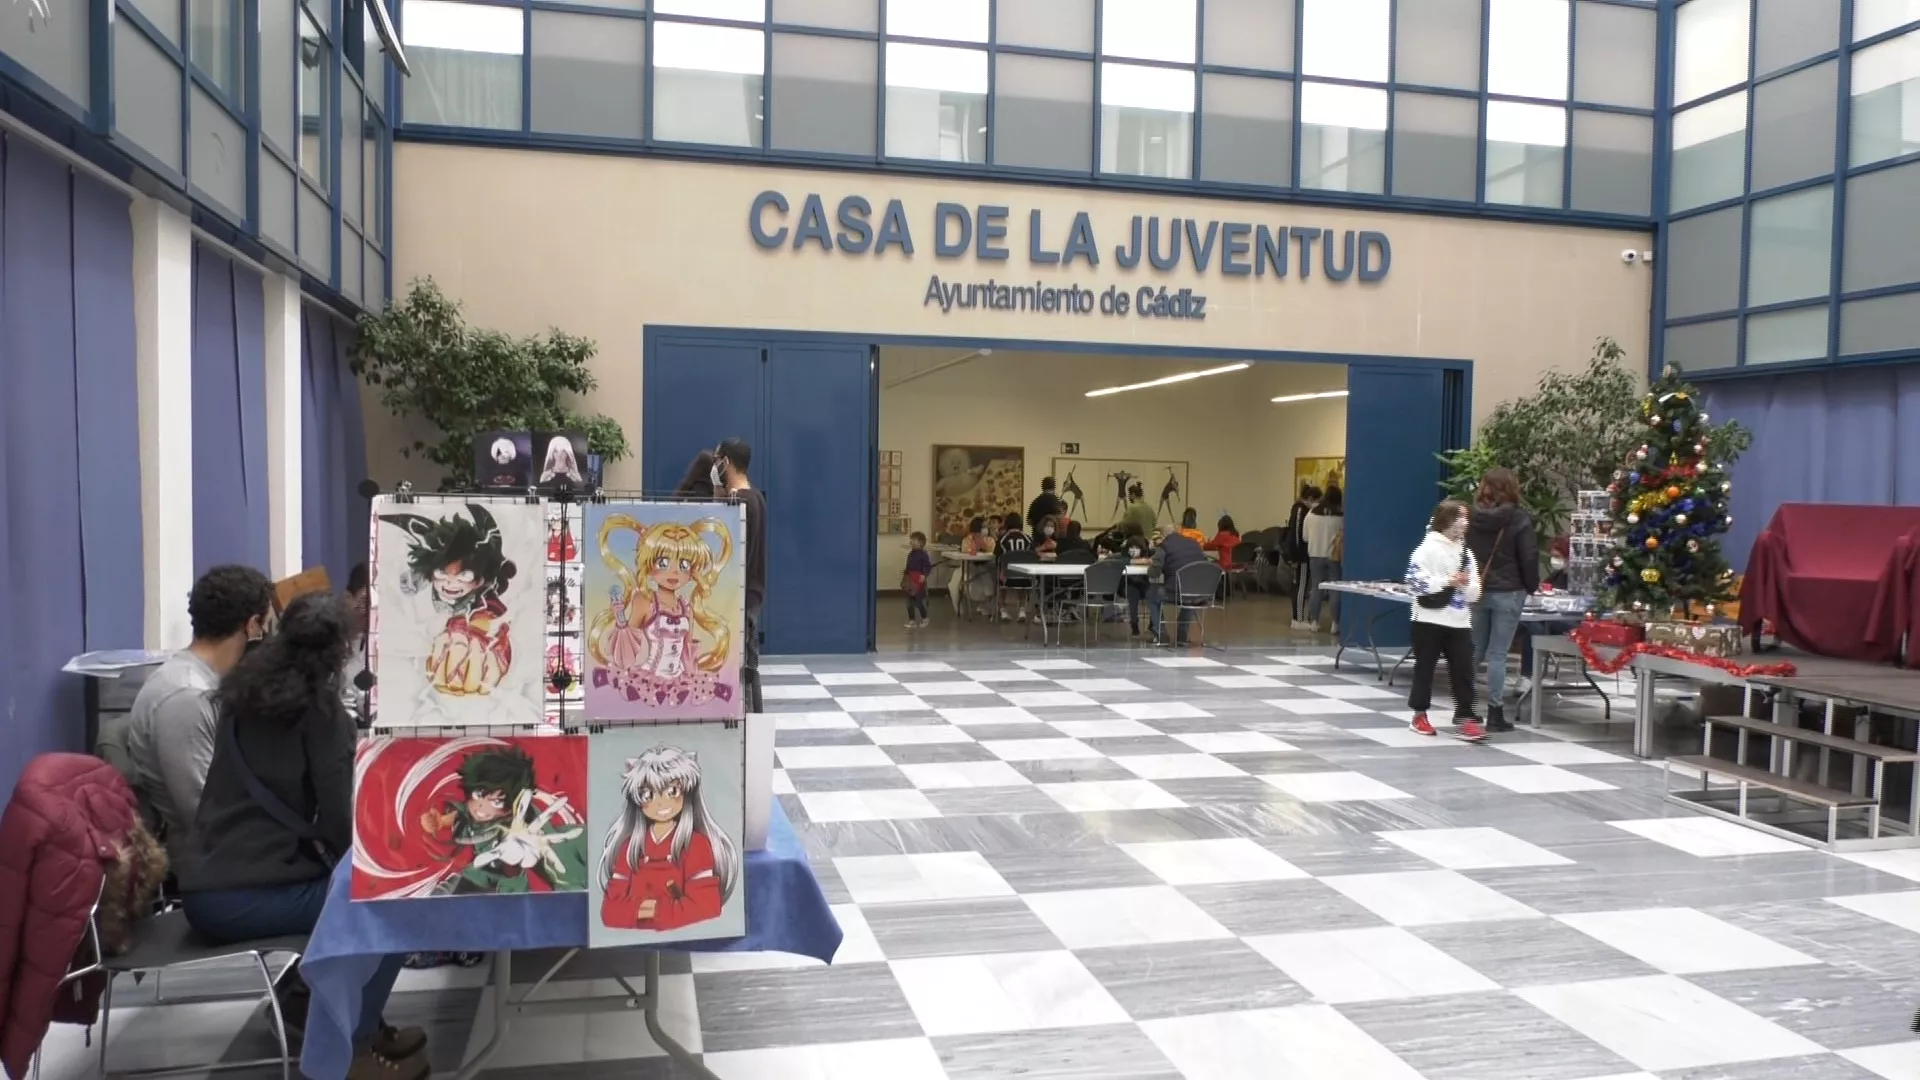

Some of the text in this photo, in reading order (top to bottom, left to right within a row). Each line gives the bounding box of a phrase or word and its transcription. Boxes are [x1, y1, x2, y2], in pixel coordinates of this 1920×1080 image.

[750, 190, 1392, 283] CASA DE LA JUVENTUD
[924, 275, 1207, 319] Ayuntamiento de Cádiz
